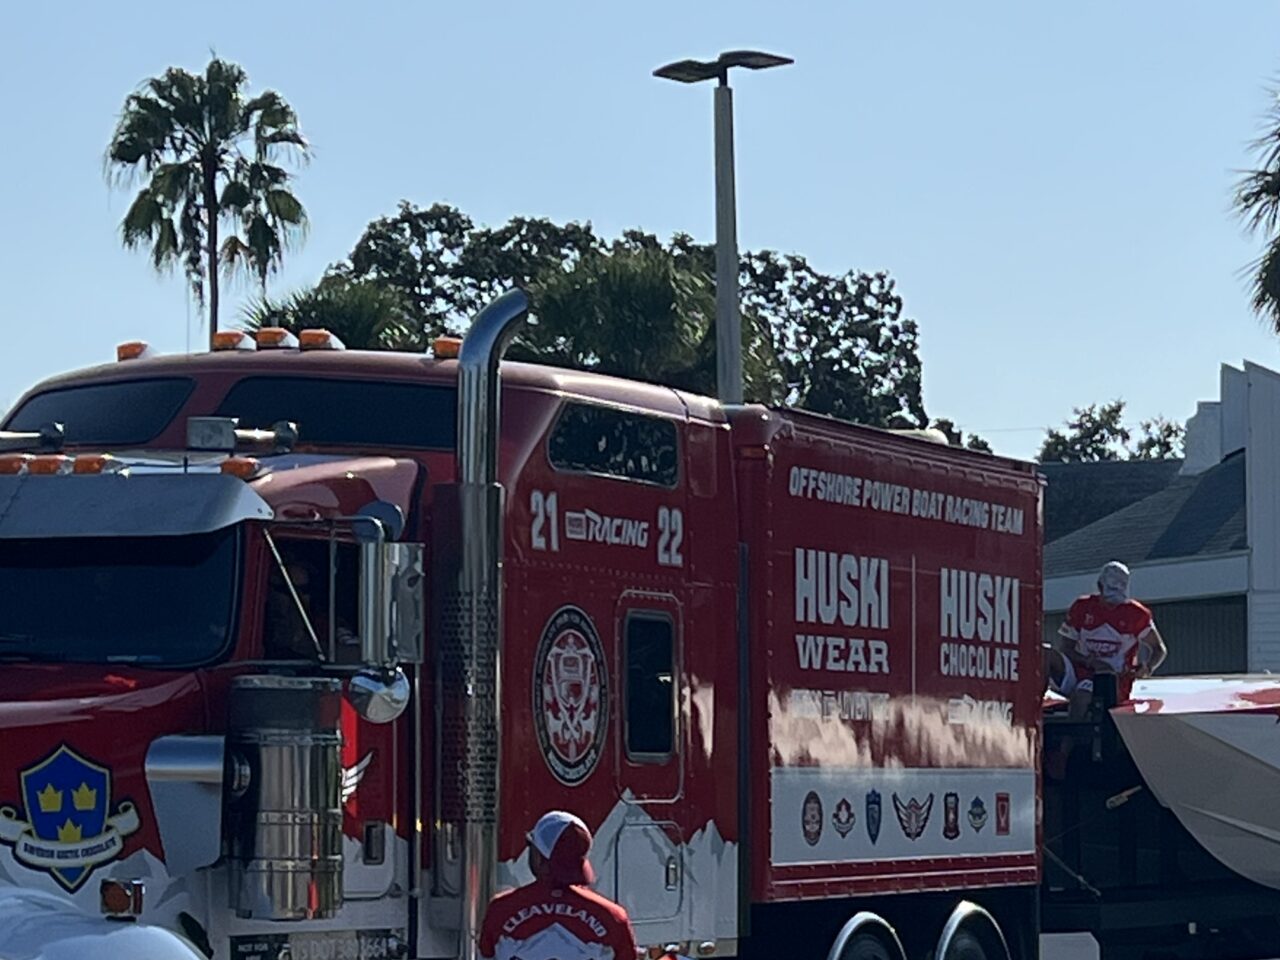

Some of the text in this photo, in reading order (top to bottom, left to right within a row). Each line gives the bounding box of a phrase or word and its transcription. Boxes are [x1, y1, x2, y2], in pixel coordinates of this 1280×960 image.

[530, 490, 683, 568] 21 RACING 22
[790, 466, 1024, 536] OFFSHORE POWER BOAT RACING TEAM
[795, 548, 889, 629] HUSKI
[940, 568, 1019, 645] HUSKI
[795, 635, 890, 674] WEAR
[940, 643, 1019, 682] CHOCOLATE
[503, 903, 607, 937] CLEAVELAND
